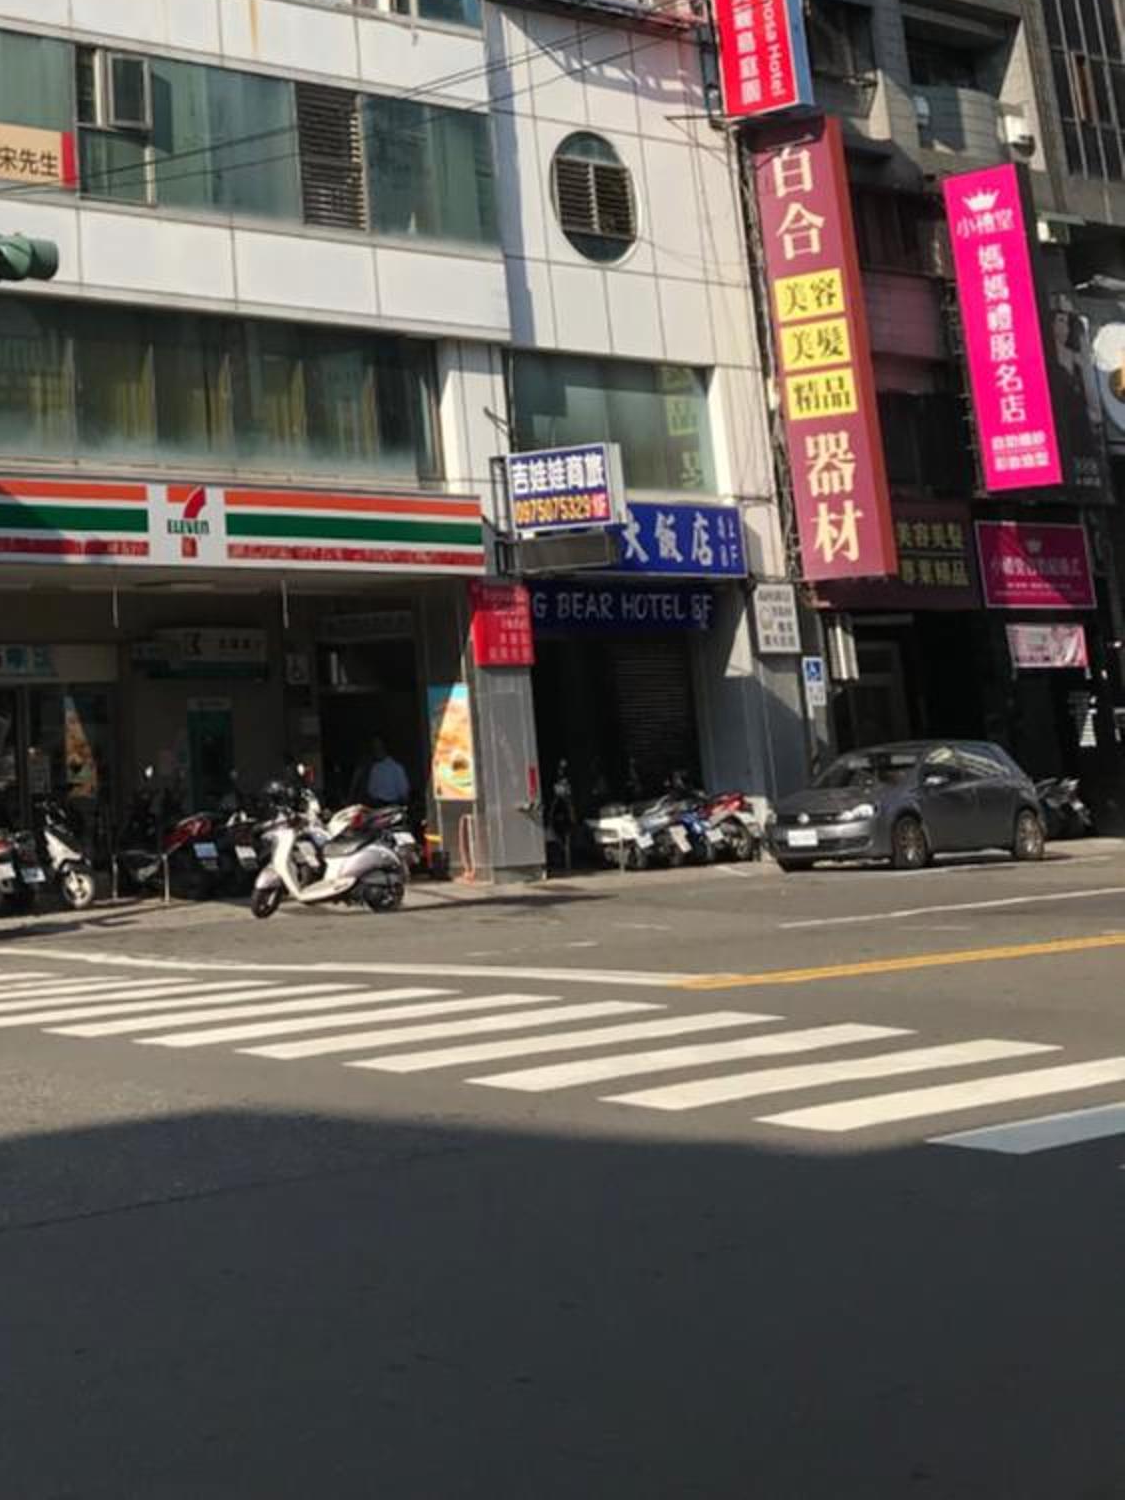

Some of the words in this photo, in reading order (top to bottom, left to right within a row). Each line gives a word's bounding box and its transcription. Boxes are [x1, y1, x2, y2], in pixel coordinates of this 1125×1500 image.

[768, 43, 786, 98] Hotel
[784, 277, 837, 314] 美容
[790, 325, 845, 362] 美髮
[793, 377, 852, 412] 精品
[805, 430, 864, 565] 器材
[556, 591, 614, 621] BEAR
[620, 592, 686, 621] HOTEL
